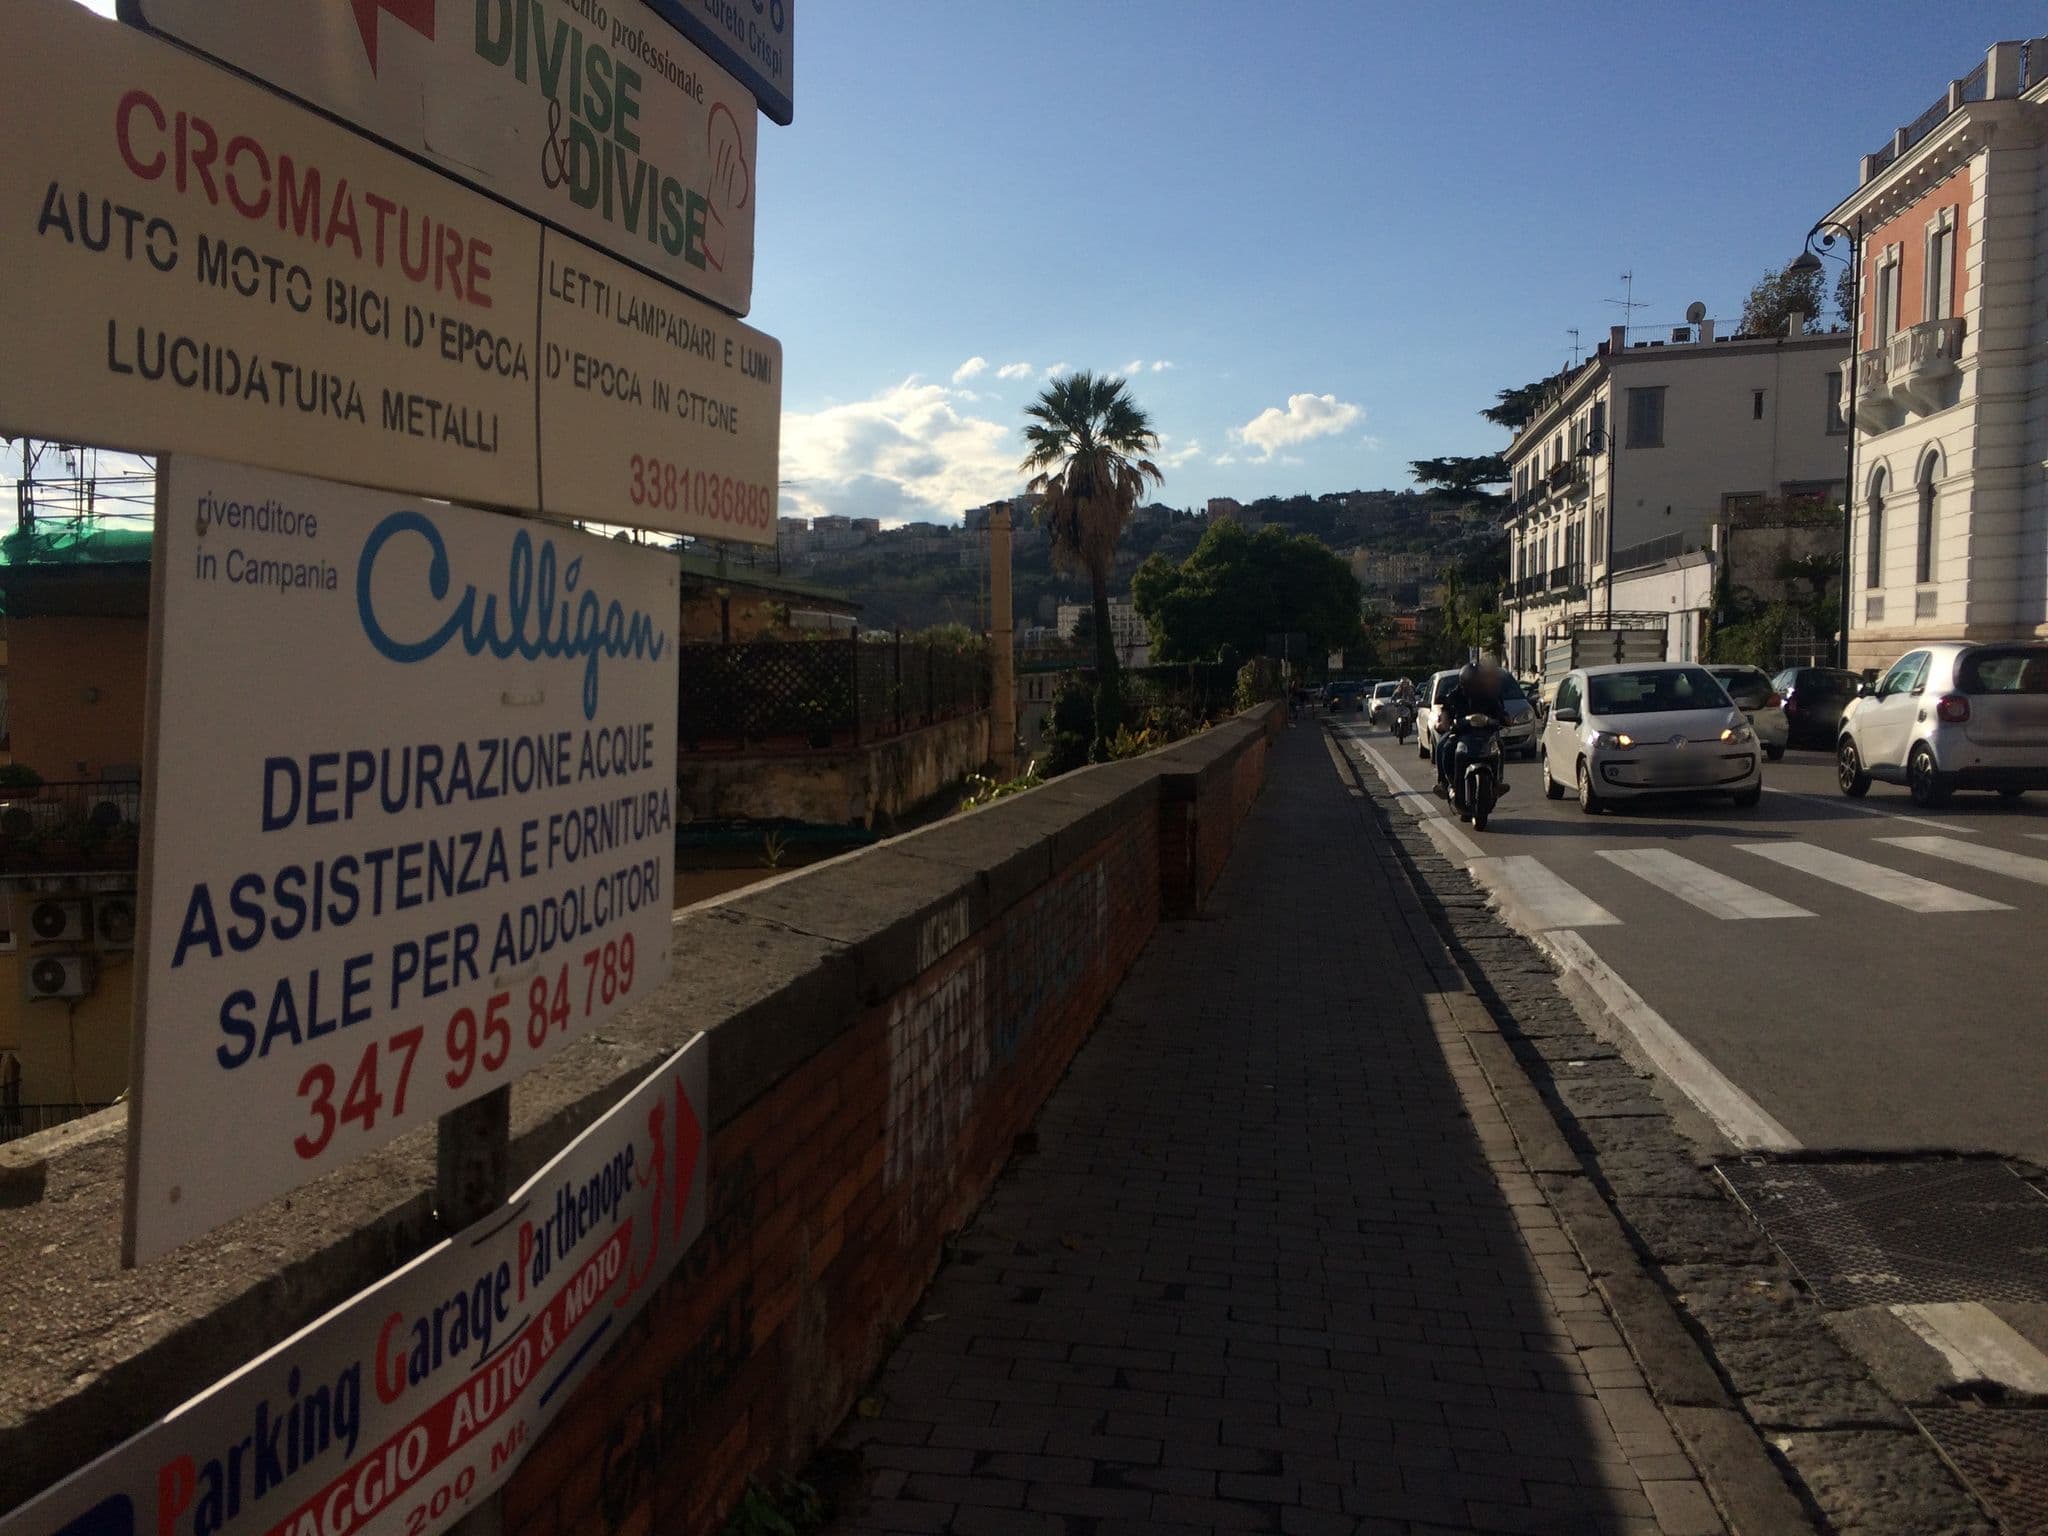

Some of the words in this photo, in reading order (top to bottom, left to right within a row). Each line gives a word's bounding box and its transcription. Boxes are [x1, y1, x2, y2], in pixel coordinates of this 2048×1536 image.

[475, 0, 642, 155] DIVISE
[611, 16, 704, 105] professionale
[749, 20, 784, 79] Crispi
[116, 89, 493, 309] CROMATURE
[542, 98, 571, 190] &
[569, 116, 707, 272] DIVISE
[37, 181, 178, 272] AUTO
[197, 233, 312, 313] MOTO
[326, 277, 390, 341] BICI
[405, 304, 529, 381] D'EPOCA
[549, 260, 609, 319] LETTI
[616, 290, 715, 361] LAMPADARI
[724, 339, 733, 368] E
[740, 344, 772, 385] LUMI
[108, 319, 366, 424] LUCIDATURA
[382, 389, 498, 453] METALLI
[546, 342, 642, 405] D'EPOCA
[652, 379, 670, 413] IN
[677, 390, 738, 434] OTTONE
[198, 490, 318, 538] rivenditore
[630, 454, 770, 531] 3381036889
[196, 546, 216, 580] in
[226, 549, 338, 594] Campania
[356, 511, 664, 720] Culligan
[262, 731, 572, 832] DEPURAZIONE
[578, 723, 654, 782] ACQUE
[171, 827, 510, 969] ASSISTENZA
[520, 820, 538, 877] E
[547, 788, 671, 869] FORNITURA
[216, 953, 374, 1069] SALE
[390, 922, 480, 1009] PER
[489, 856, 661, 974] ADDOLCITORI
[293, 1026, 424, 1159] 347
[445, 992, 511, 1090] 95
[527, 962, 572, 1050] 84
[583, 932, 635, 1018] 789
[155, 1365, 361, 1536] Parking
[375, 1260, 511, 1405] Garage
[518, 1142, 636, 1304] Parthenope
[284, 1426, 428, 1536] AGGIO
[447, 1338, 531, 1448] AUTO
[539, 1311, 556, 1358] &
[563, 1238, 621, 1331] MOTO
[405, 1465, 475, 1536] 200
